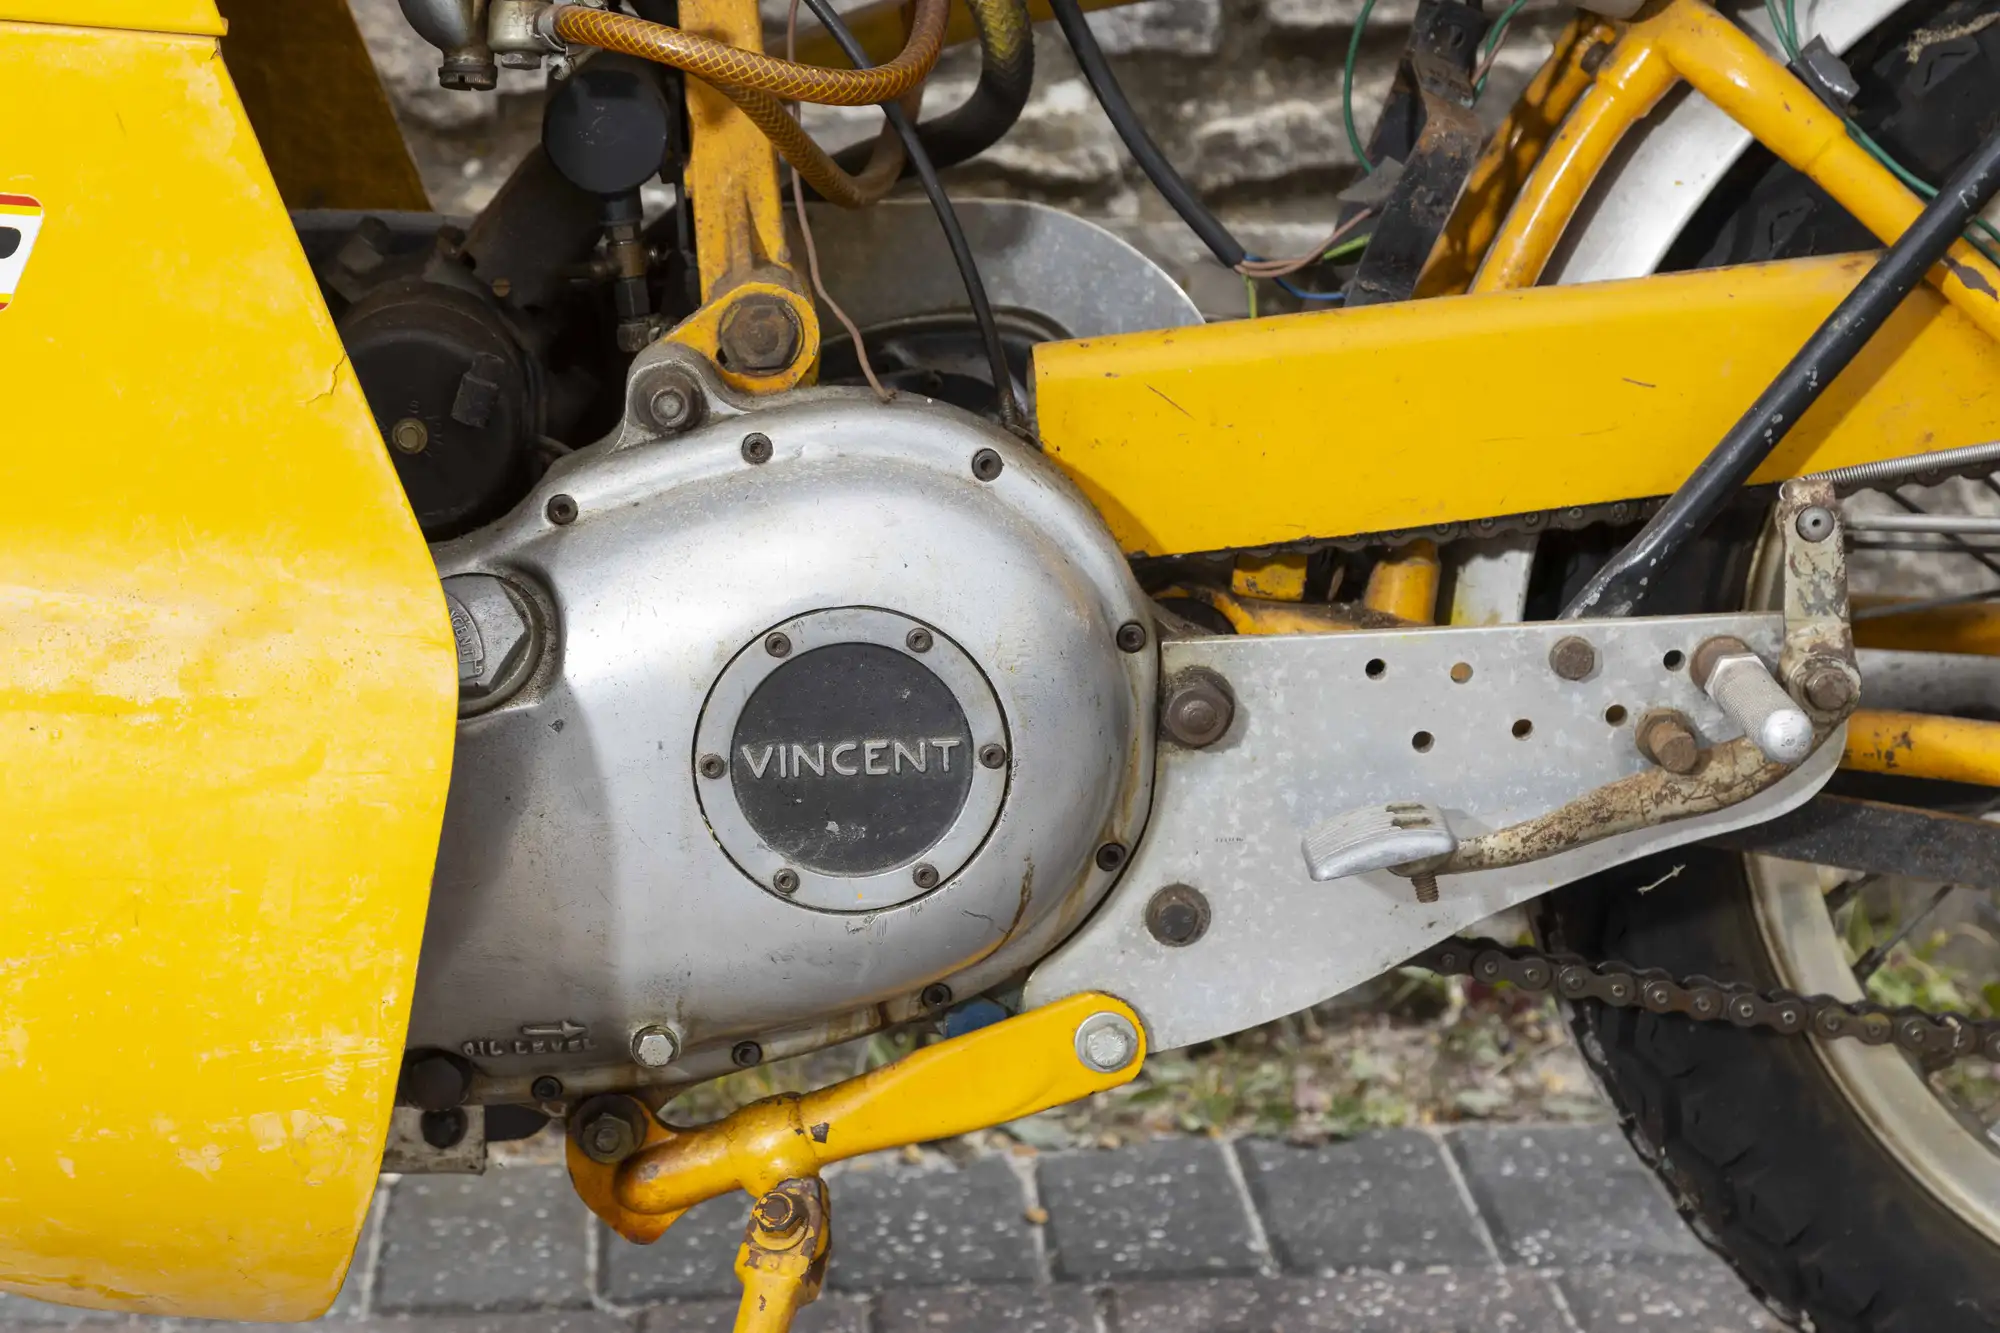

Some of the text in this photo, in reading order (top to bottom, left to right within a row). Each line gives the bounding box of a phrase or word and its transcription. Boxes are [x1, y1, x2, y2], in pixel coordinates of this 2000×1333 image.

[741, 737, 961, 779] VINCENT
[462, 1038, 598, 1056] OIL LEVEL
